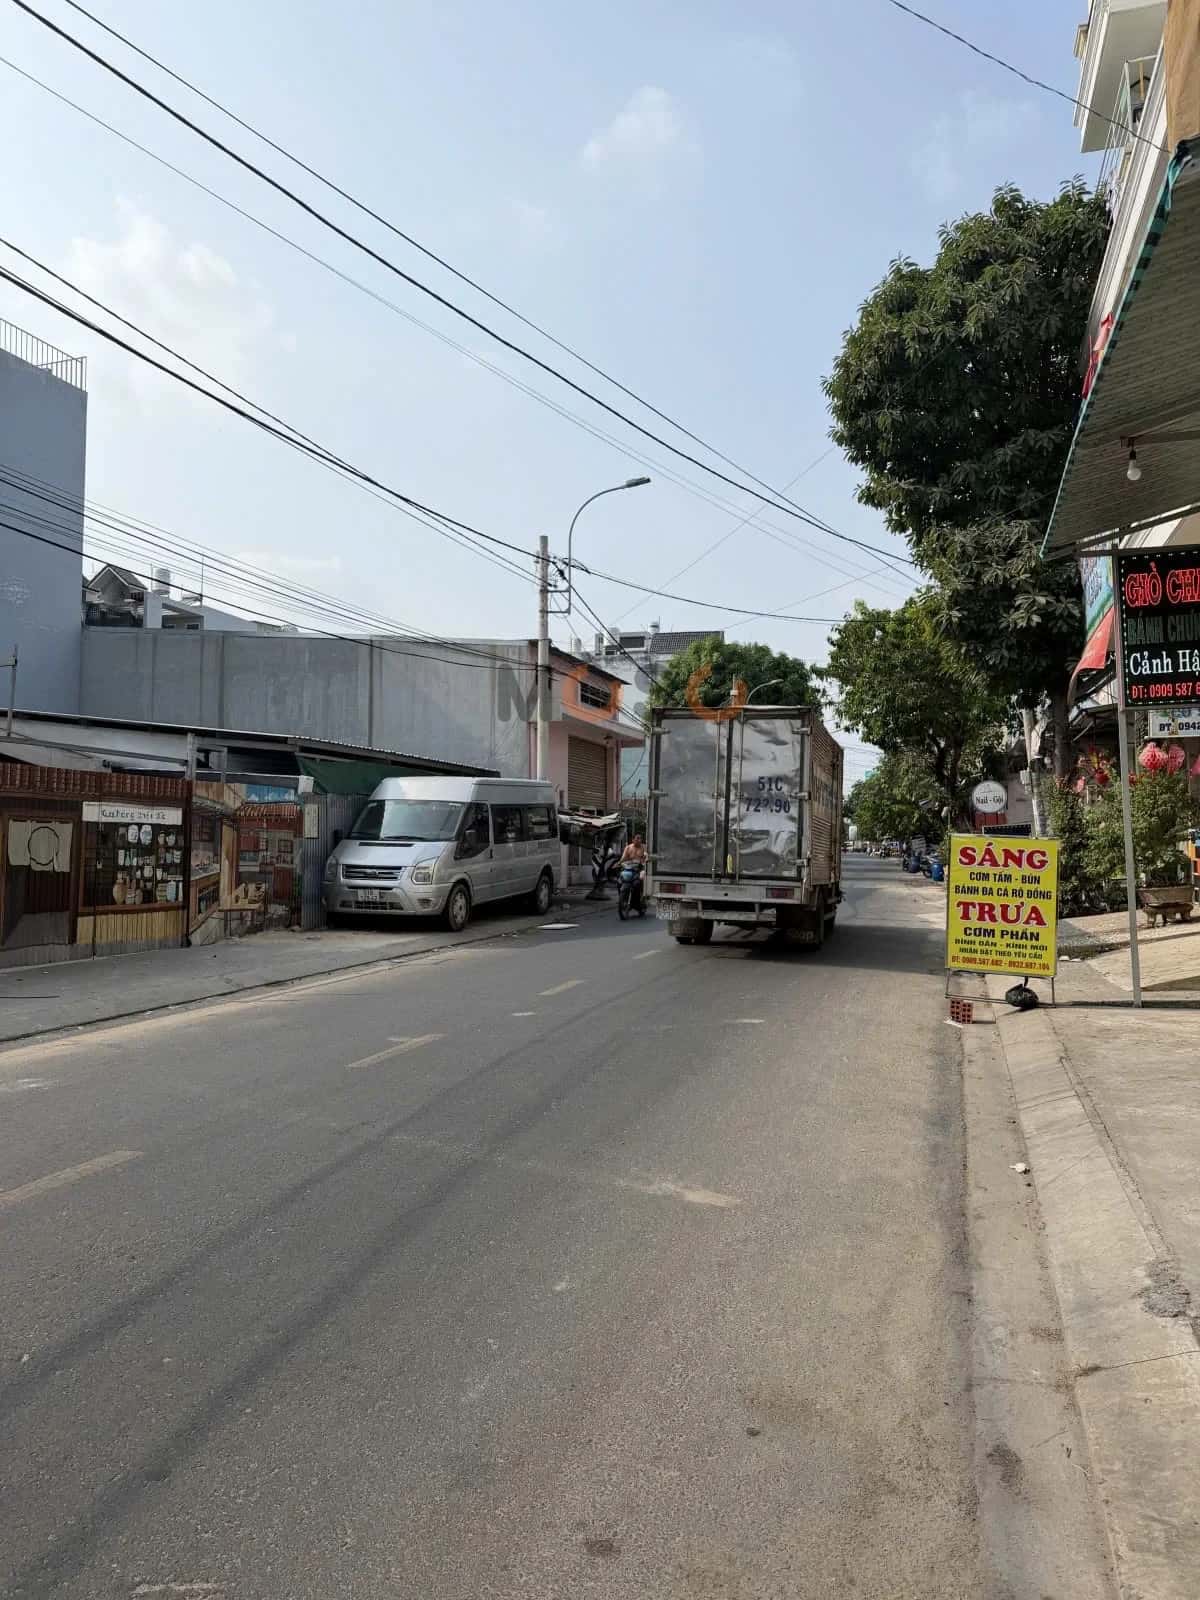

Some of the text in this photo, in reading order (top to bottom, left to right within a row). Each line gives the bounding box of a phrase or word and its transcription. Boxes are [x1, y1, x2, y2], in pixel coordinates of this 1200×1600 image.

[1125, 561, 1162, 608] GIÒ
[1127, 610, 1165, 645] BÁNH
[1130, 650, 1173, 676] Cảnh
[1149, 684, 1173, 698] 0909
[1175, 682, 1193, 696] 587
[758, 776, 783, 792] 51C
[958, 842, 1049, 870] SÁNG
[969, 871, 990, 881] CƠM
[993, 870, 1012, 883] TẤM
[1021, 873, 1041, 885] BÚN
[954, 883, 979, 896] BÁNH
[997, 885, 1009, 897] CÁ
[956, 900, 1047, 926] TRƯA
[963, 926, 995, 938] CƠM
